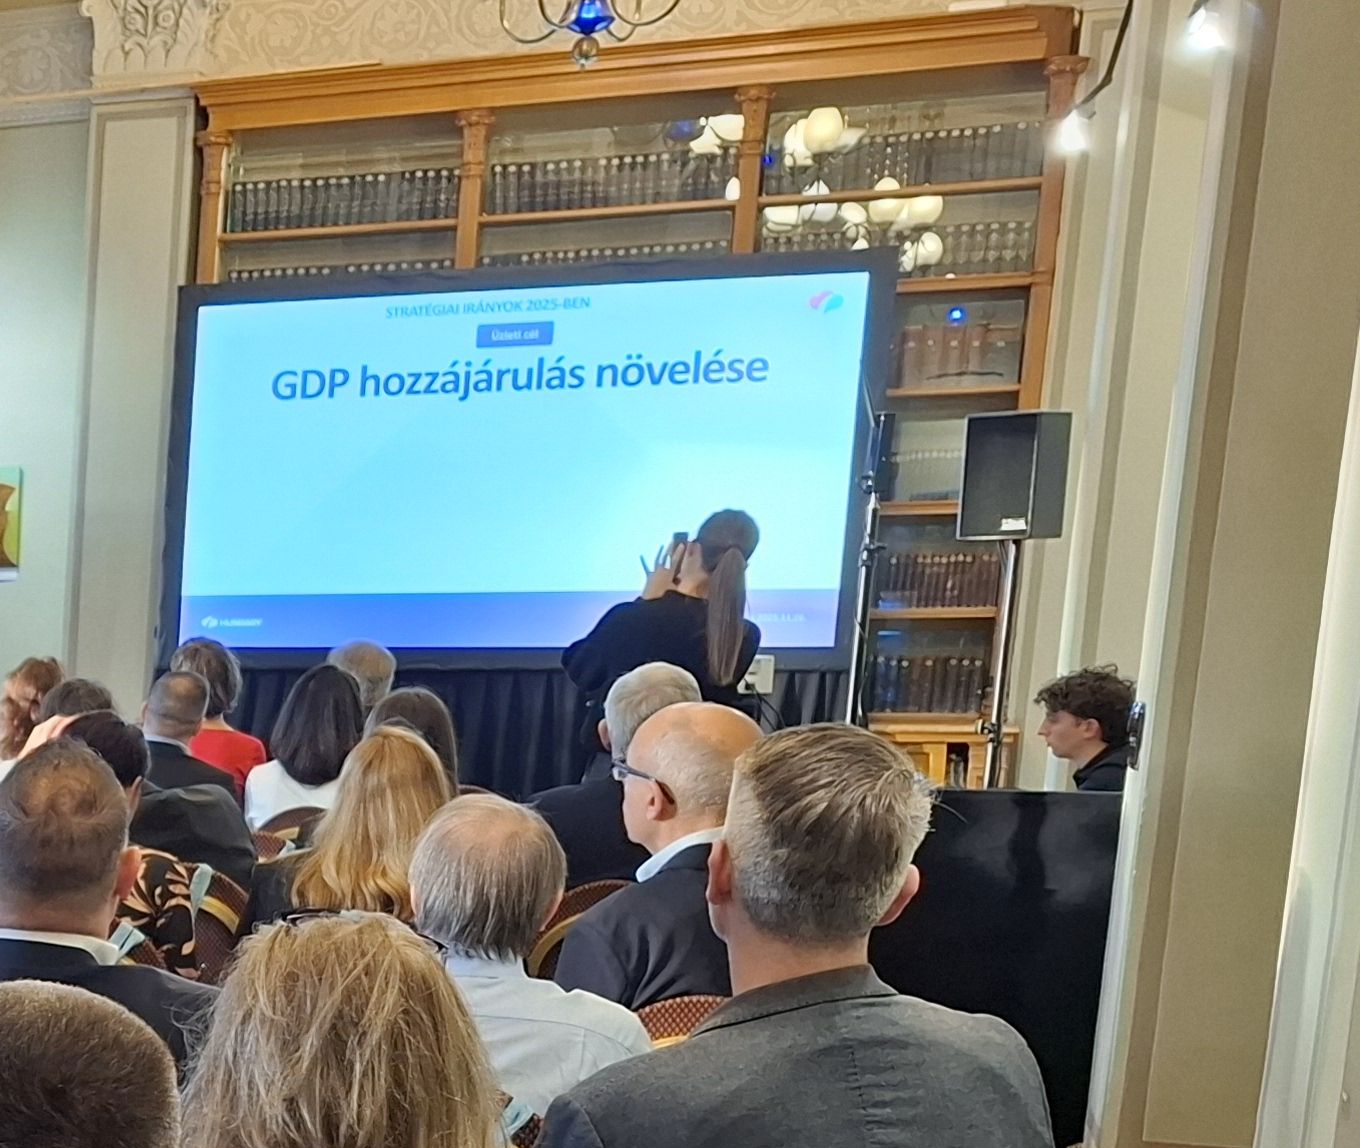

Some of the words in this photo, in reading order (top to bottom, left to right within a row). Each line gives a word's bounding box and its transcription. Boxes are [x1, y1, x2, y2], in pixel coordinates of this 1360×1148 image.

[385, 302, 459, 319] STRATÉGIAI
[463, 299, 524, 315] IRÁNYOK
[526, 296, 591, 312] 2025-BEN
[271, 367, 350, 400] GDP
[359, 355, 585, 402] hozzájárulás
[595, 348, 770, 389] növelése
